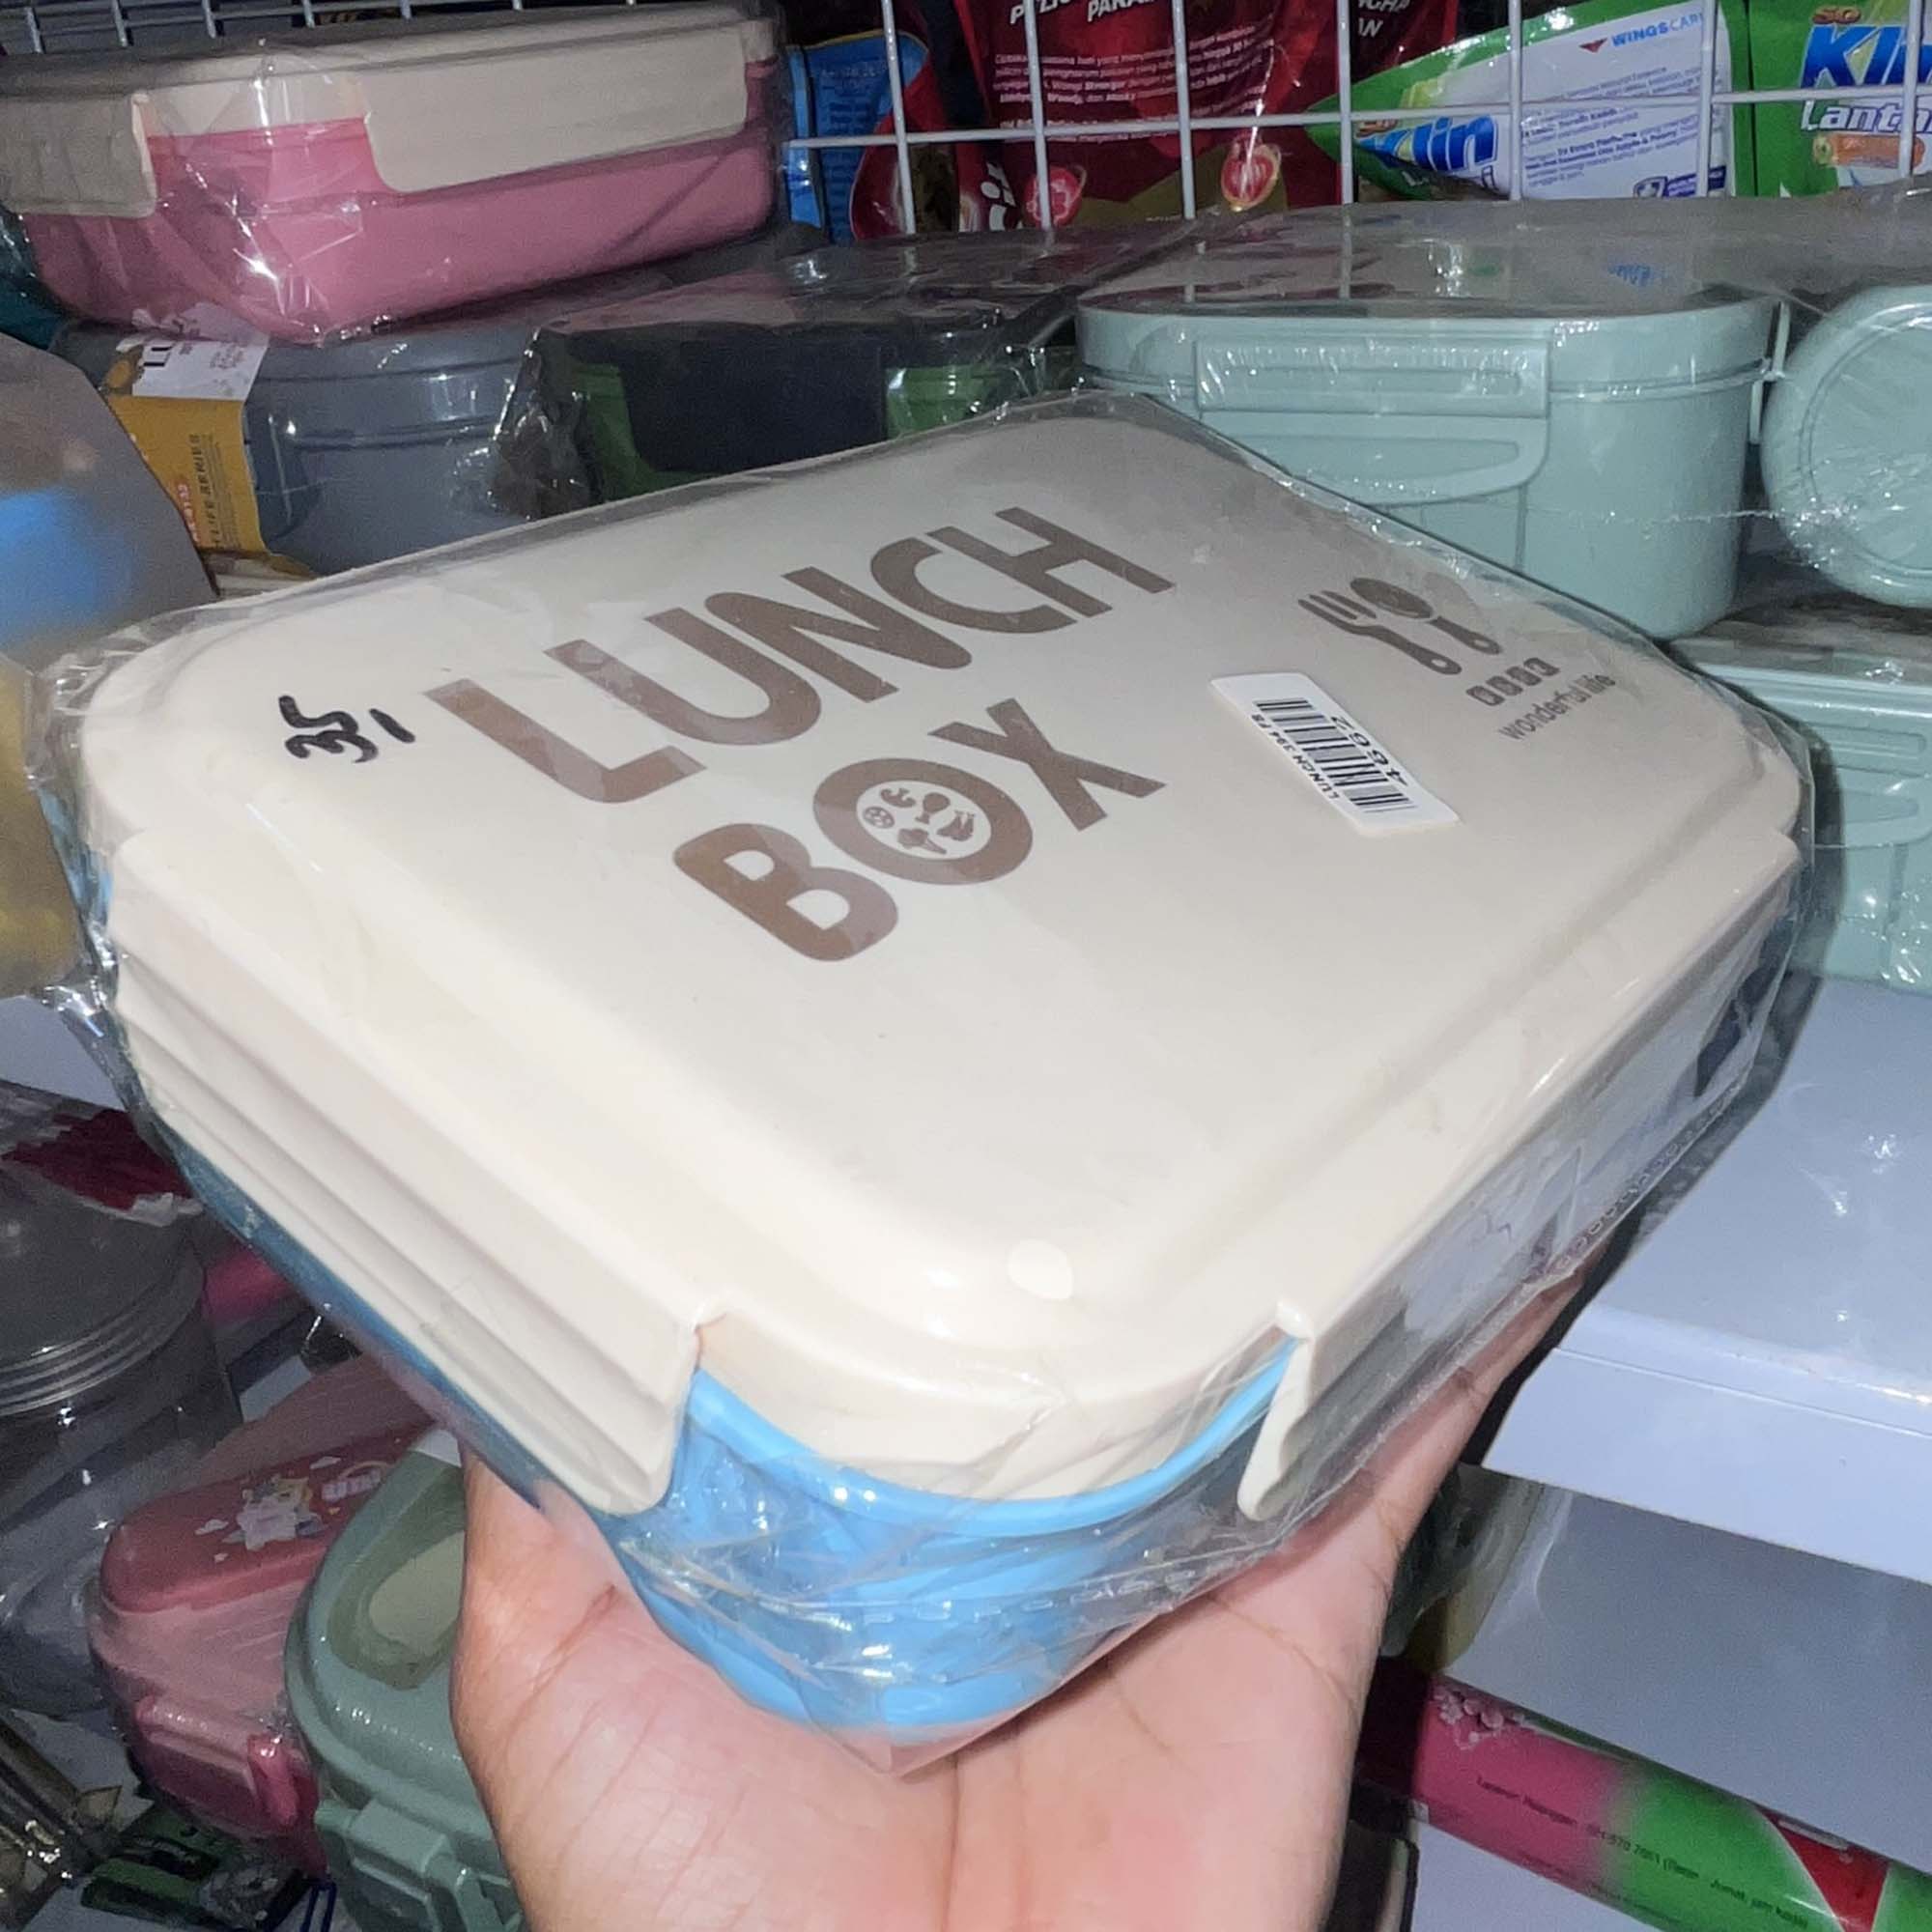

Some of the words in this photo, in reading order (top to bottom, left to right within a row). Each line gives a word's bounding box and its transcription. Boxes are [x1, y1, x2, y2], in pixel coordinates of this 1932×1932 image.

[1611, 13, 1702, 46] WINGSCAR
[425, 506, 1176, 804] LUNCH
[1293, 753, 1341, 800] LUNCH
[1330, 715, 1409, 787] 4662
[672, 697, 1168, 962] BOX
